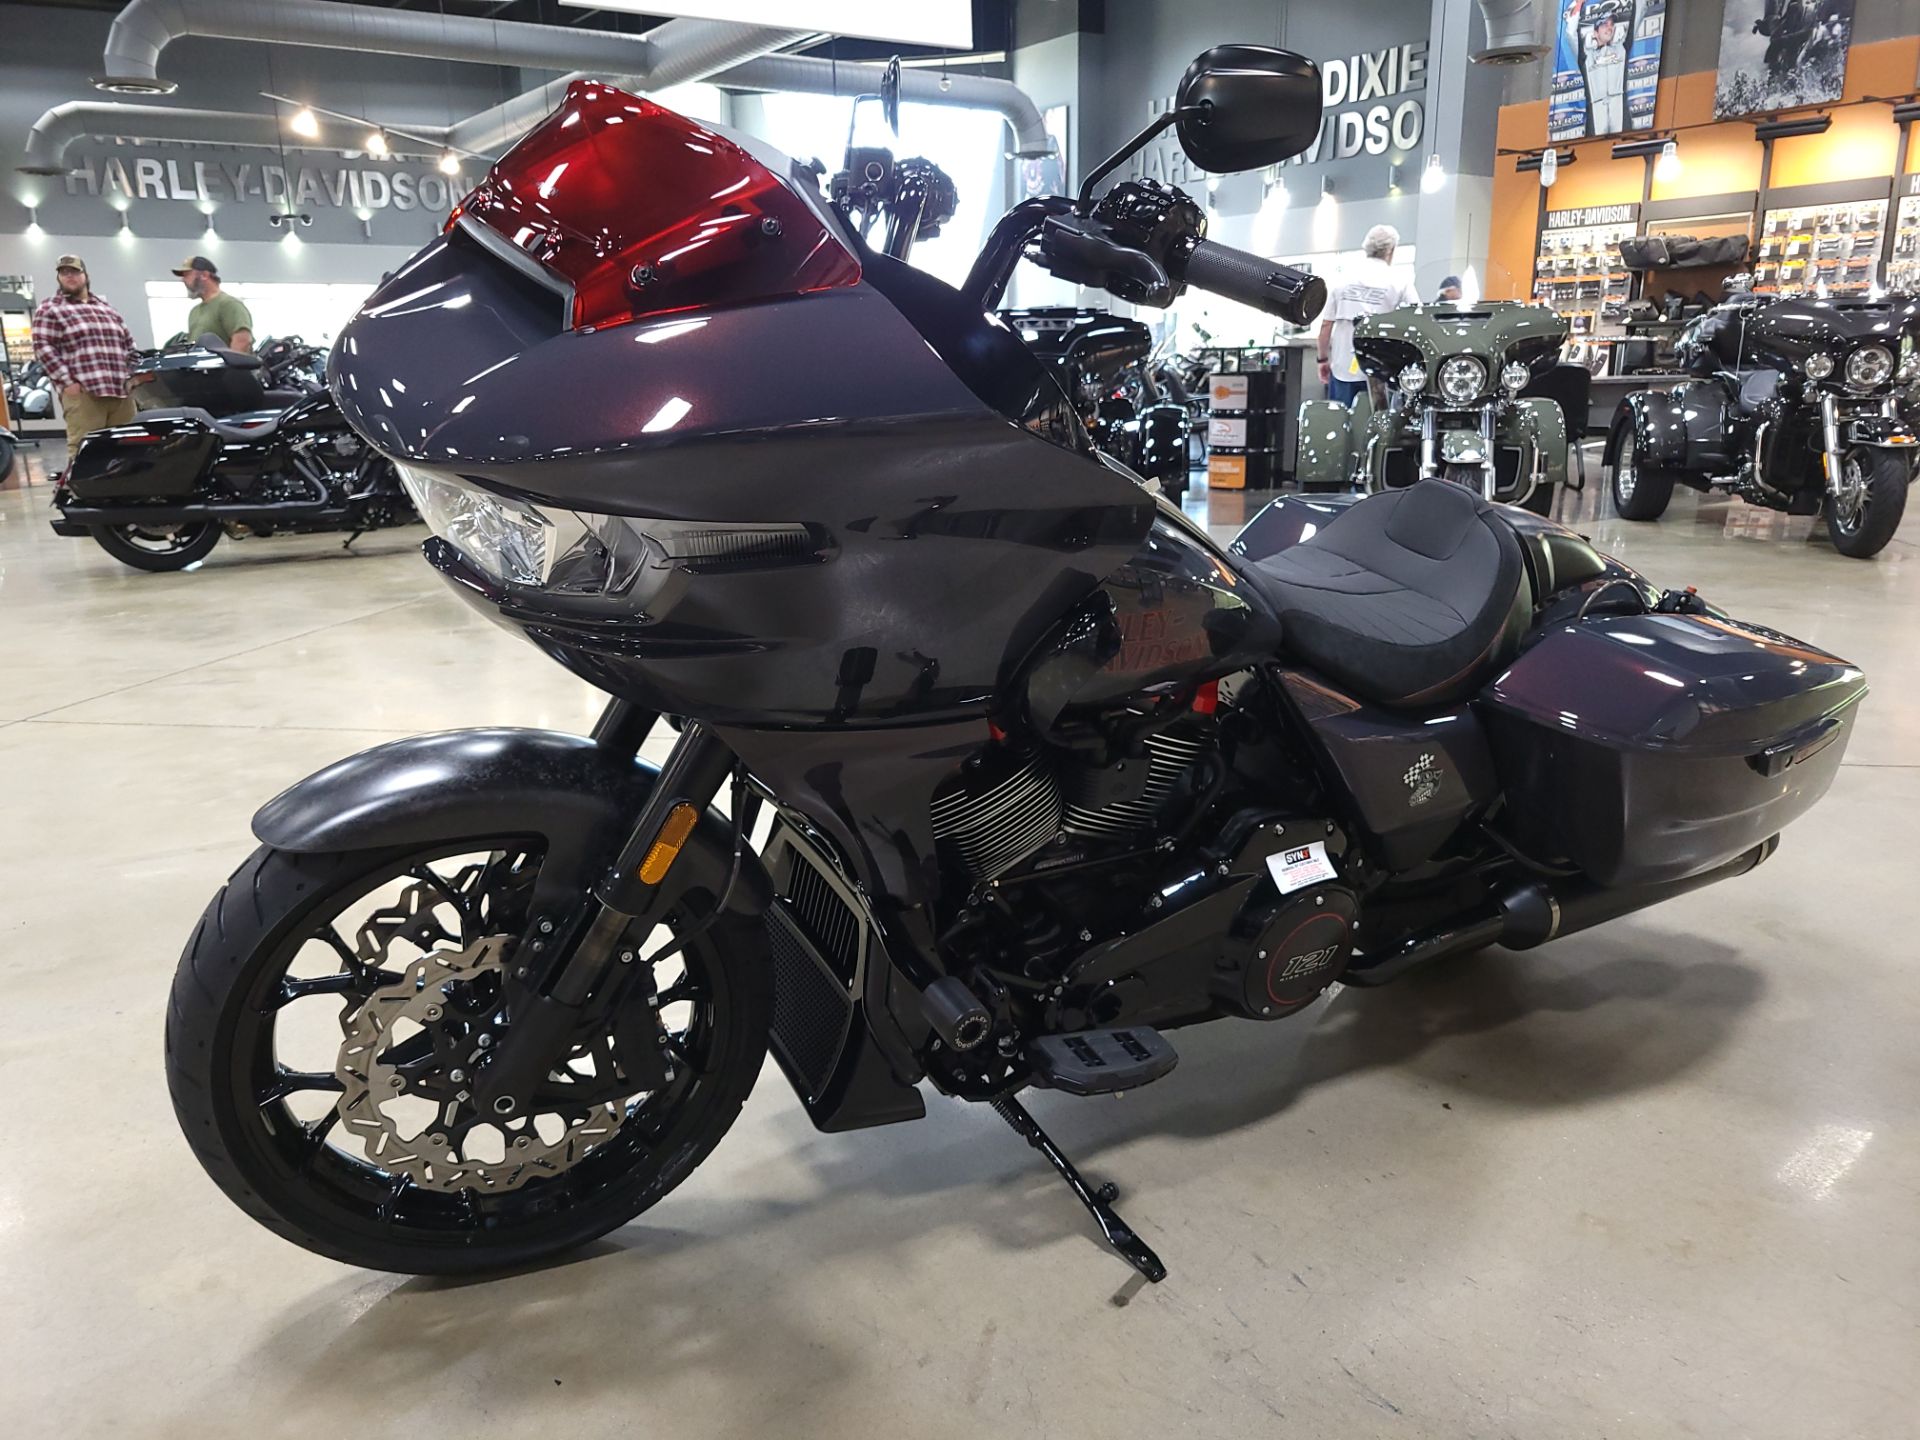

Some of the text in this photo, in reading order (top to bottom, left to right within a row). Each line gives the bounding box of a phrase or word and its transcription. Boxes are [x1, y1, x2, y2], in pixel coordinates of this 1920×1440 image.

[1322, 41, 1428, 107] DIXIE
[1548, 205, 1632, 228] HARLEY-DAVIDSON
[1282, 944, 1339, 977] 121
